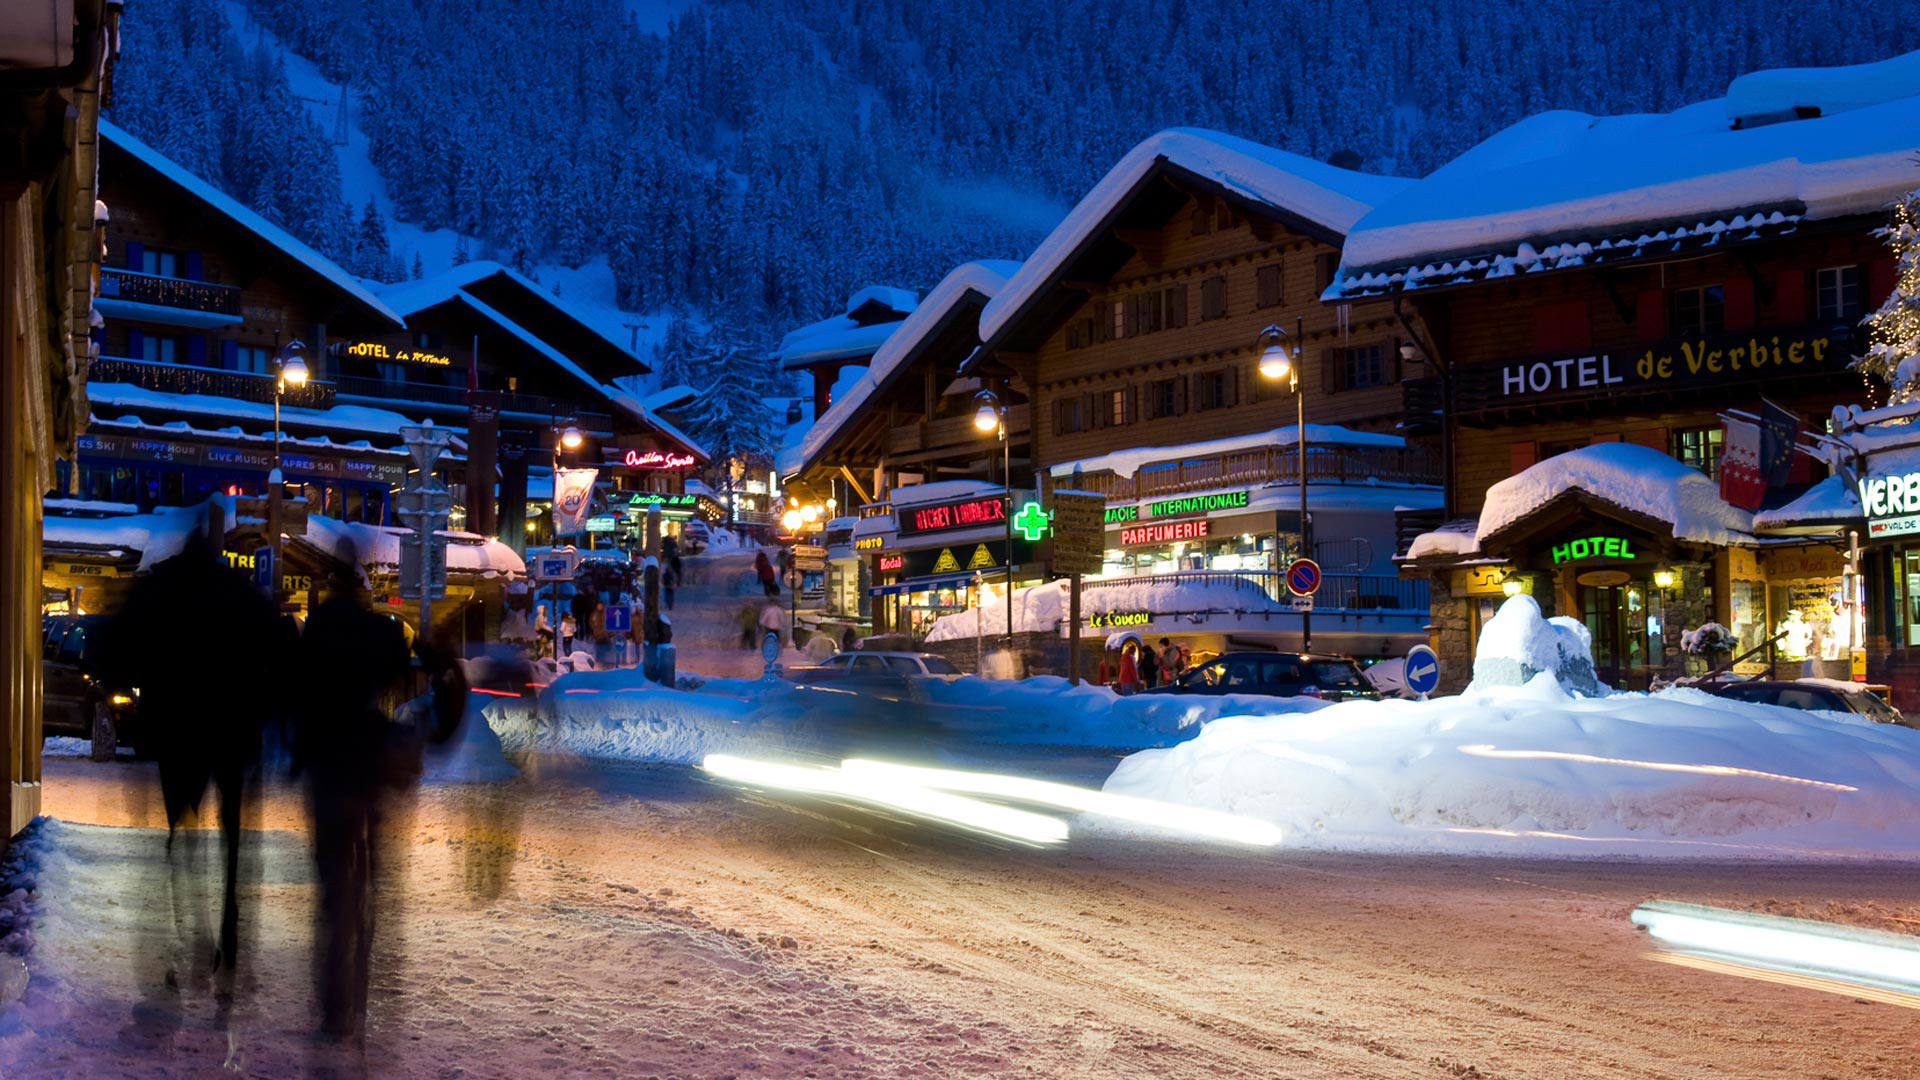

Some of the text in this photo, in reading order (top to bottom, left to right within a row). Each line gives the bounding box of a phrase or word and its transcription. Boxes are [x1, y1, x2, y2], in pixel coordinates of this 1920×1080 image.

[1502, 336, 1829, 395] HOTEL de Verbier
[96, 441, 115, 451] SKI
[131, 440, 195, 455] HAPPY HOUR
[208, 452, 268, 466] LIVE MUSIC
[317, 462, 334, 472] SKI
[346, 462, 403, 474] HAPPY HOUR
[629, 493, 667, 504] Location
[1857, 472, 1920, 518] VERB
[1149, 491, 1247, 517] INTERNATIONALE
[1121, 521, 1208, 545] PARFUMERIE
[855, 536, 884, 549] PHOTO
[1552, 536, 1635, 565] HOTEL
[70, 565, 102, 575] BIKES
[1089, 612, 1103, 628] Le
